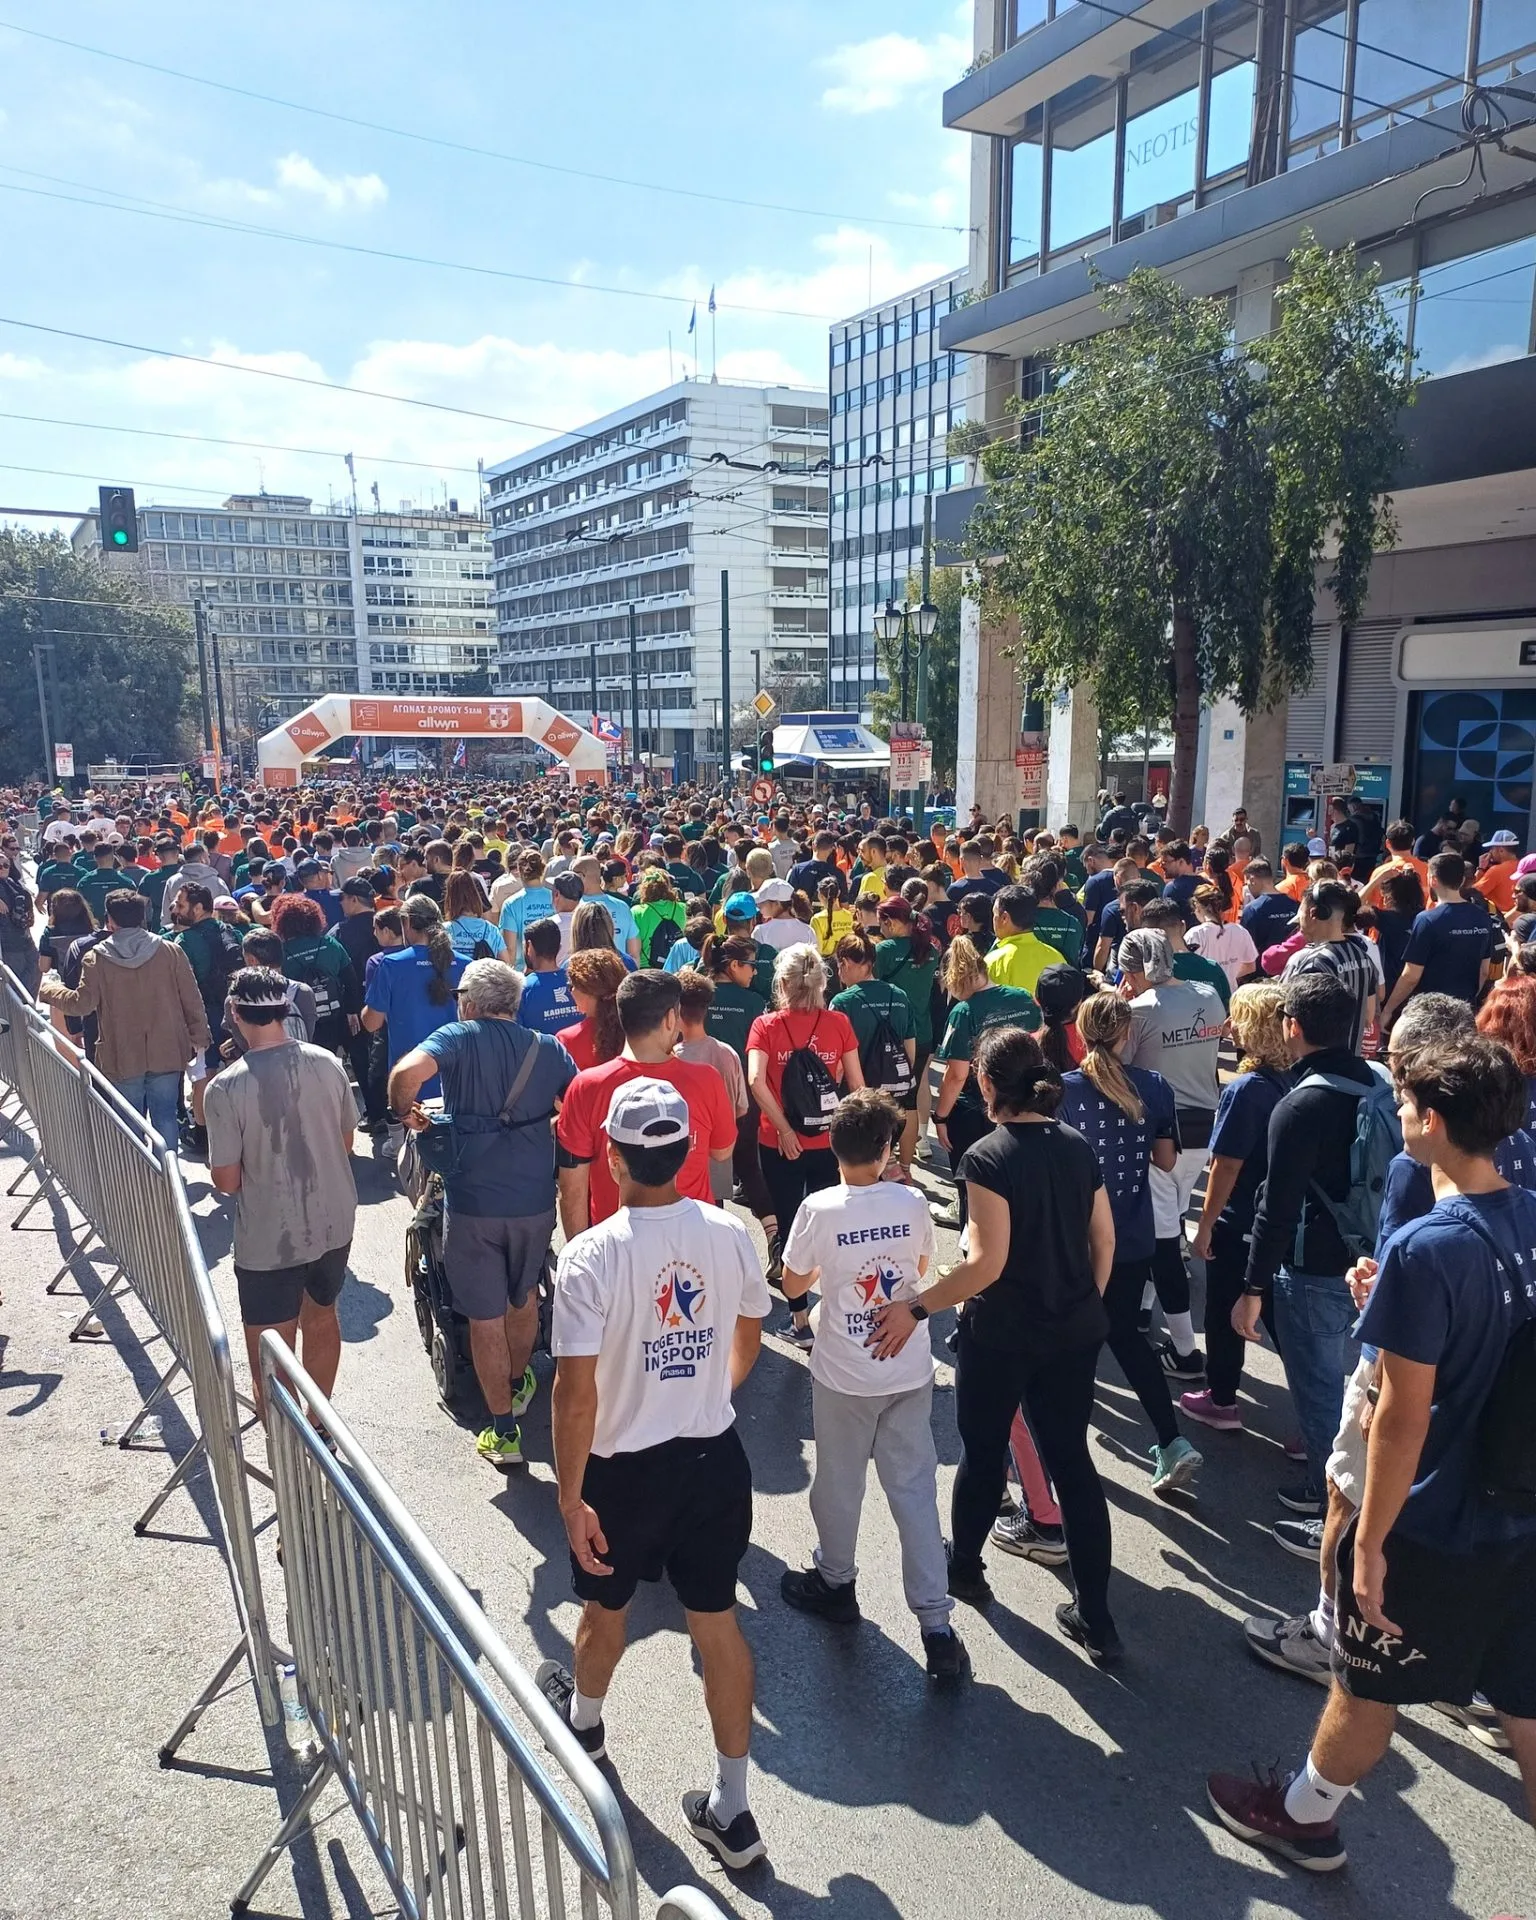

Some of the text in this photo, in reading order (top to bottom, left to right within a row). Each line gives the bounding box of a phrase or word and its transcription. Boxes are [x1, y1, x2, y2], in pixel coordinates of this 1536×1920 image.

[1127, 116, 1199, 172] NEOTIS
[393, 704, 426, 714] ΑΓΩΝΑΣ
[427, 704, 462, 715] ΔΡΟΜΟΥ
[301, 728, 325, 738] allwyn
[418, 717, 460, 731] allwyn
[1162, 1019, 1222, 1044] METAdras
[836, 1223, 911, 1247] REFEREE
[845, 1304, 886, 1325] TOGET
[642, 1327, 714, 1355] TOGETHER
[848, 1325, 863, 1335] IN
[645, 1341, 713, 1373] IN SPORT
[1345, 1614, 1428, 1667] NKY
